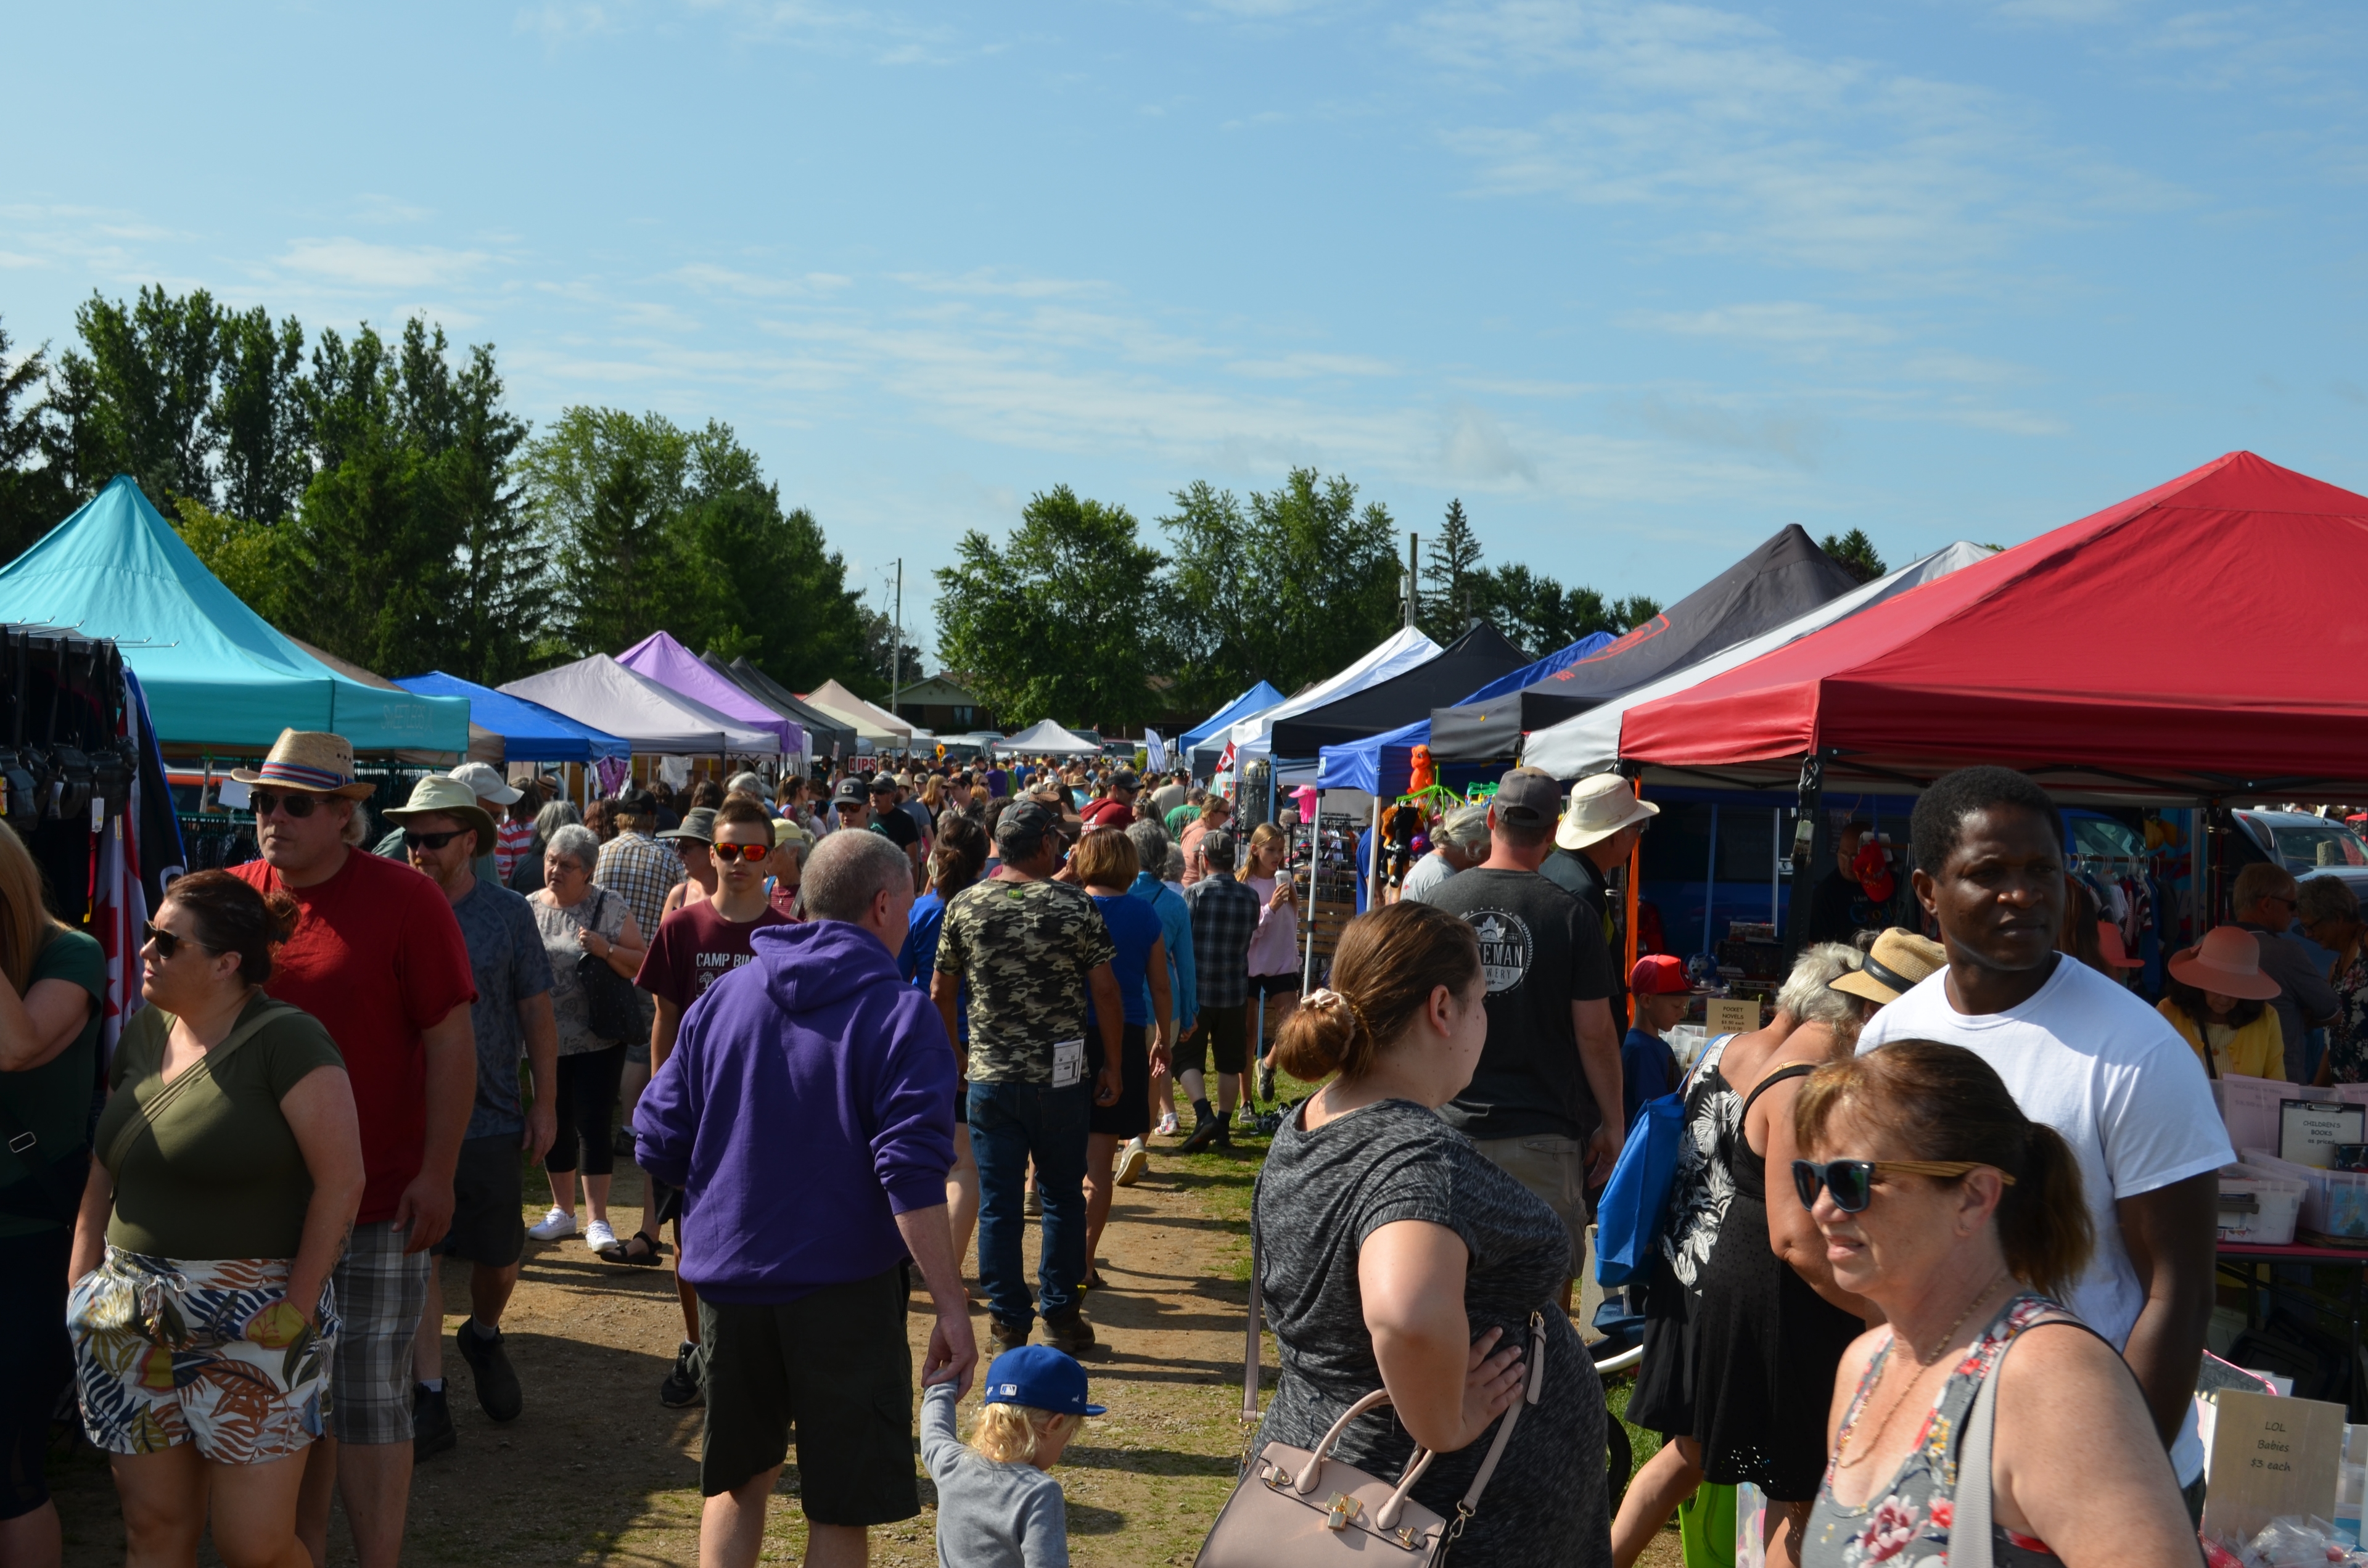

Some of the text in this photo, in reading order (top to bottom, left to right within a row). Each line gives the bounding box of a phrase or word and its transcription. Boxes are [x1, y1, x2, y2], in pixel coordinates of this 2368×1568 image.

[849, 758, 876, 772] DIPS
[696, 953, 730, 967] CAMP
[1476, 943, 1523, 967] EMAN
[1486, 967, 1511, 980] WERY
[2303, 1120, 2341, 1128] CHILDREN'S
[2265, 1421, 2286, 1432] LOL
[2257, 1440, 2290, 1453] Babies
[2250, 1458, 2291, 1472] $3 each
